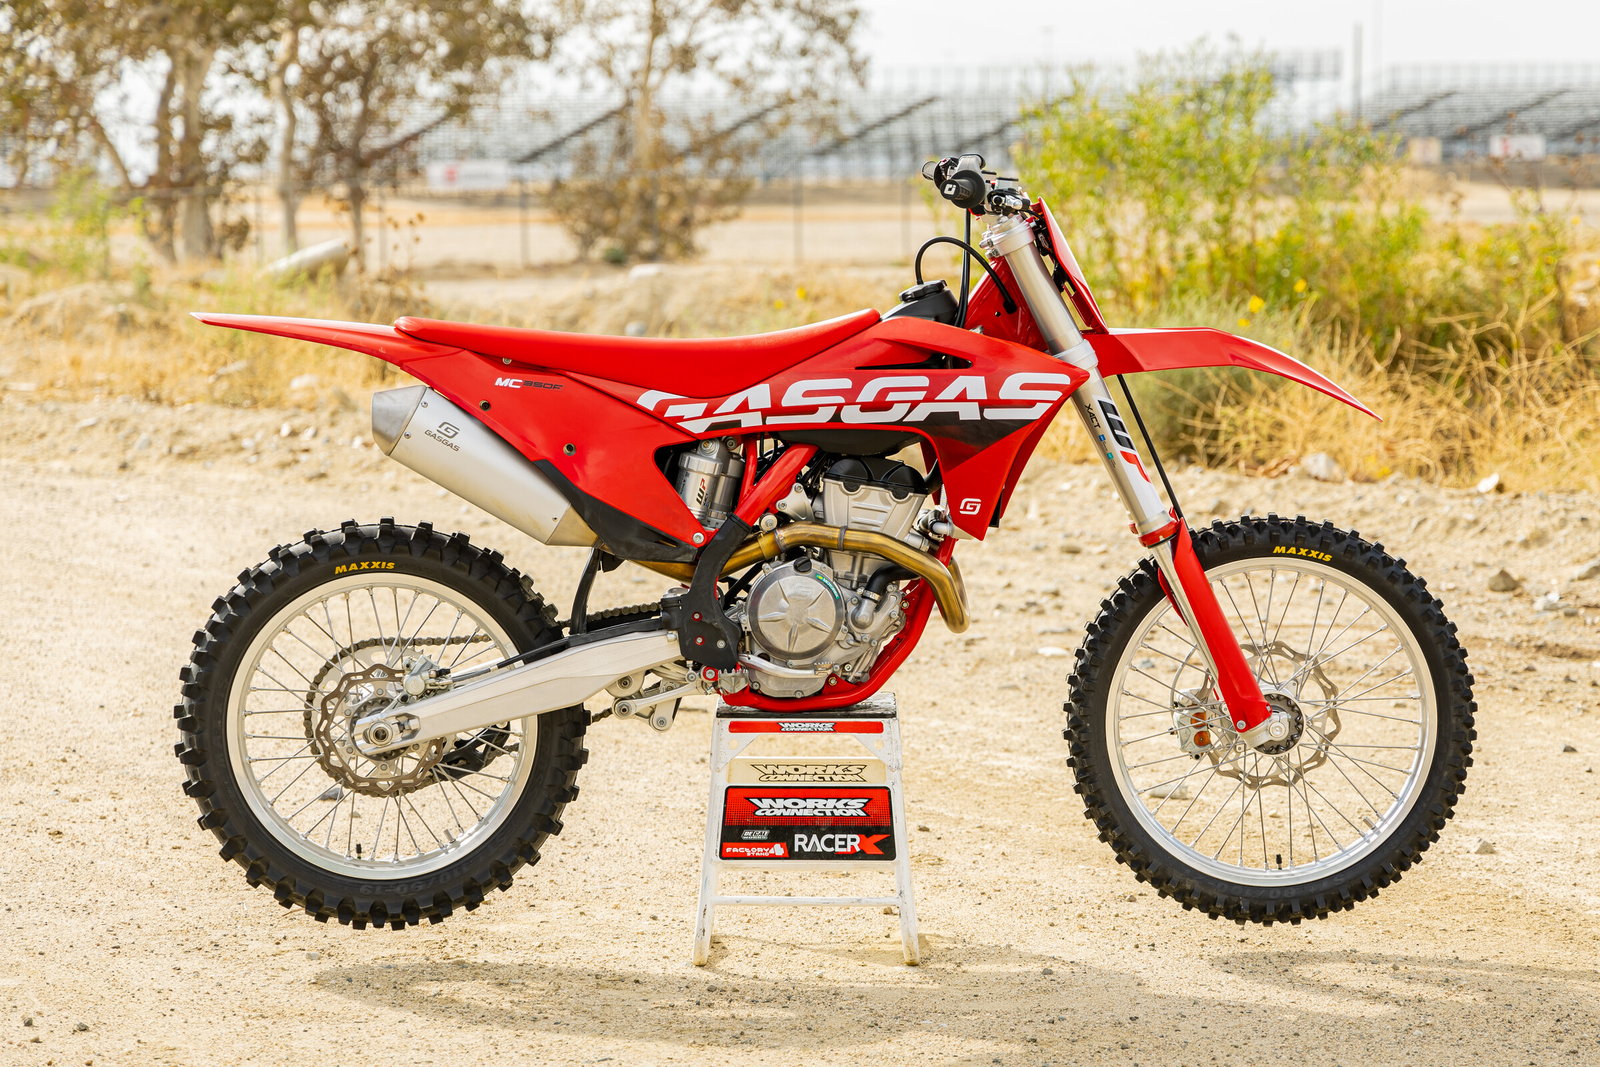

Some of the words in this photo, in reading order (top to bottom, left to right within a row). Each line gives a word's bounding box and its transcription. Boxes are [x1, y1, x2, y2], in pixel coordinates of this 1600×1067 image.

[636, 372, 1071, 434] GASGAS
[1085, 403, 1101, 429] XACT
[424, 429, 461, 452] GASGAS
[1272, 545, 1333, 562] MAXXIS
[334, 561, 396, 575] MAXXIS
[751, 764, 868, 775] WORKS
[758, 774, 868, 783] CONNECTION
[748, 798, 869, 809] WORKS
[754, 808, 868, 817] CONNECTION
